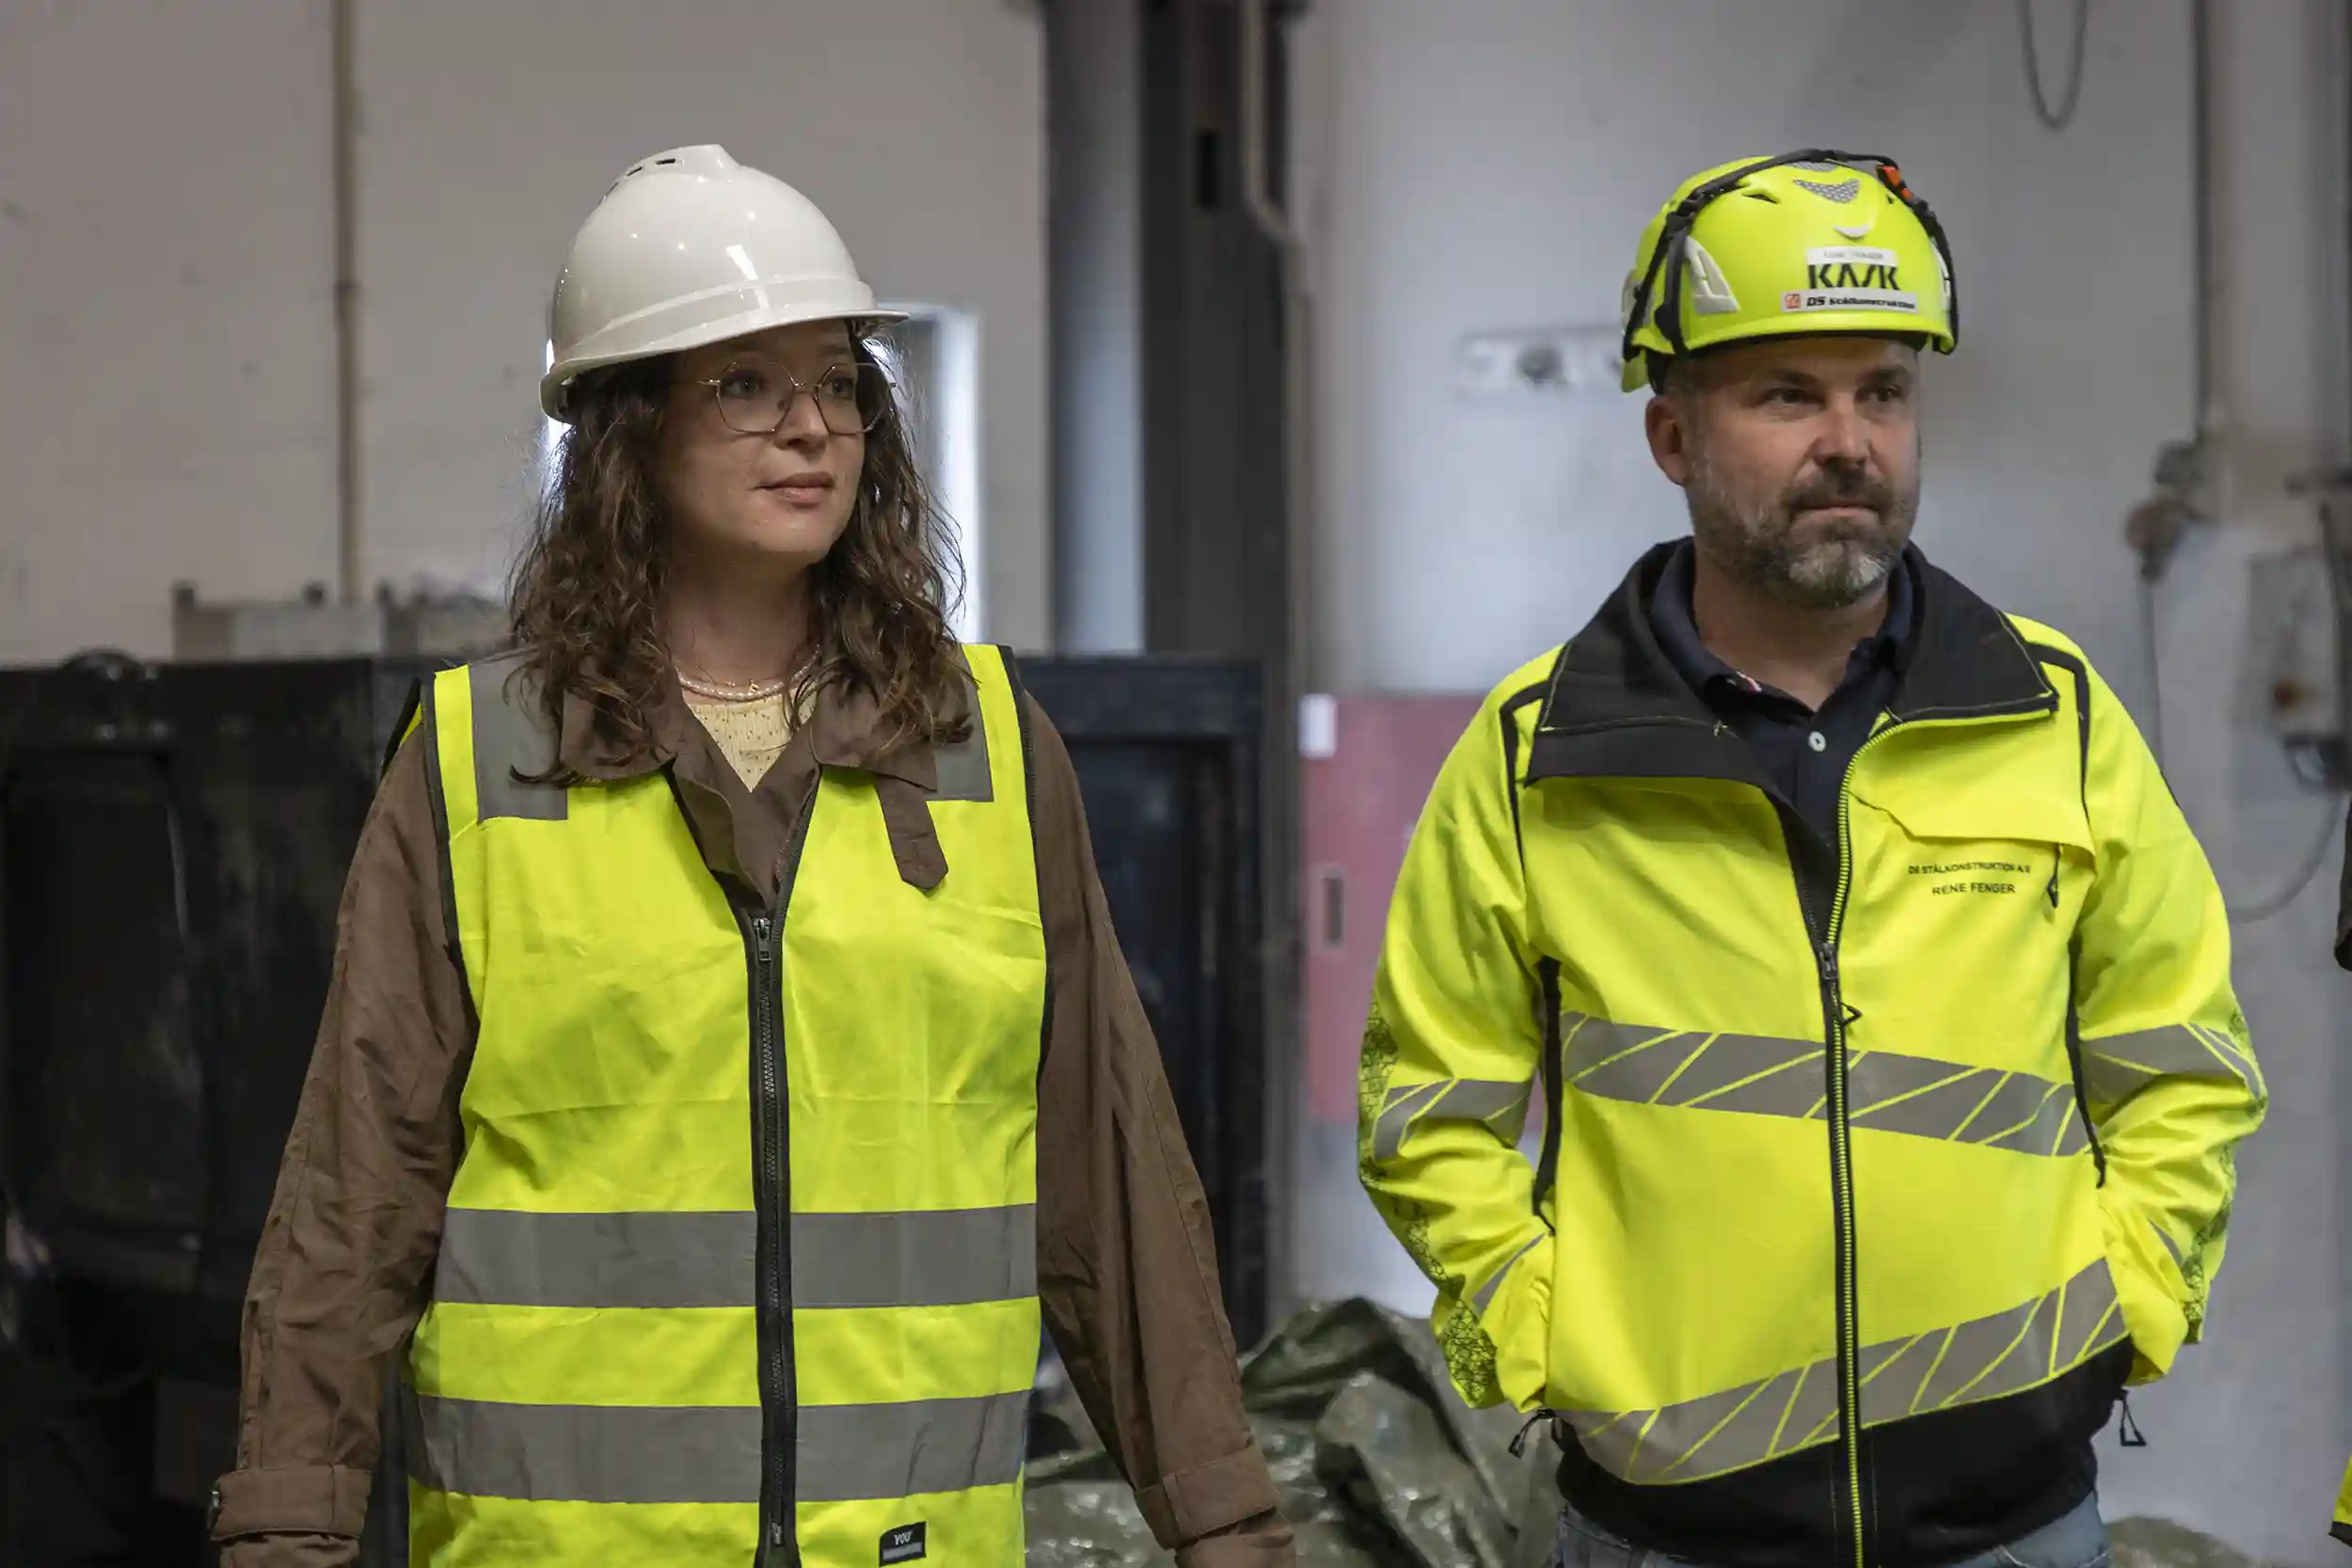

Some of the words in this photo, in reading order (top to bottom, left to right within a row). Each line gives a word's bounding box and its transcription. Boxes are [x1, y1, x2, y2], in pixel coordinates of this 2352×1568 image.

[1807, 262, 1900, 291] KASK
[1806, 296, 1826, 307] DS
[1931, 882, 1967, 895] RENE
[1970, 882, 2016, 894] FENGER
